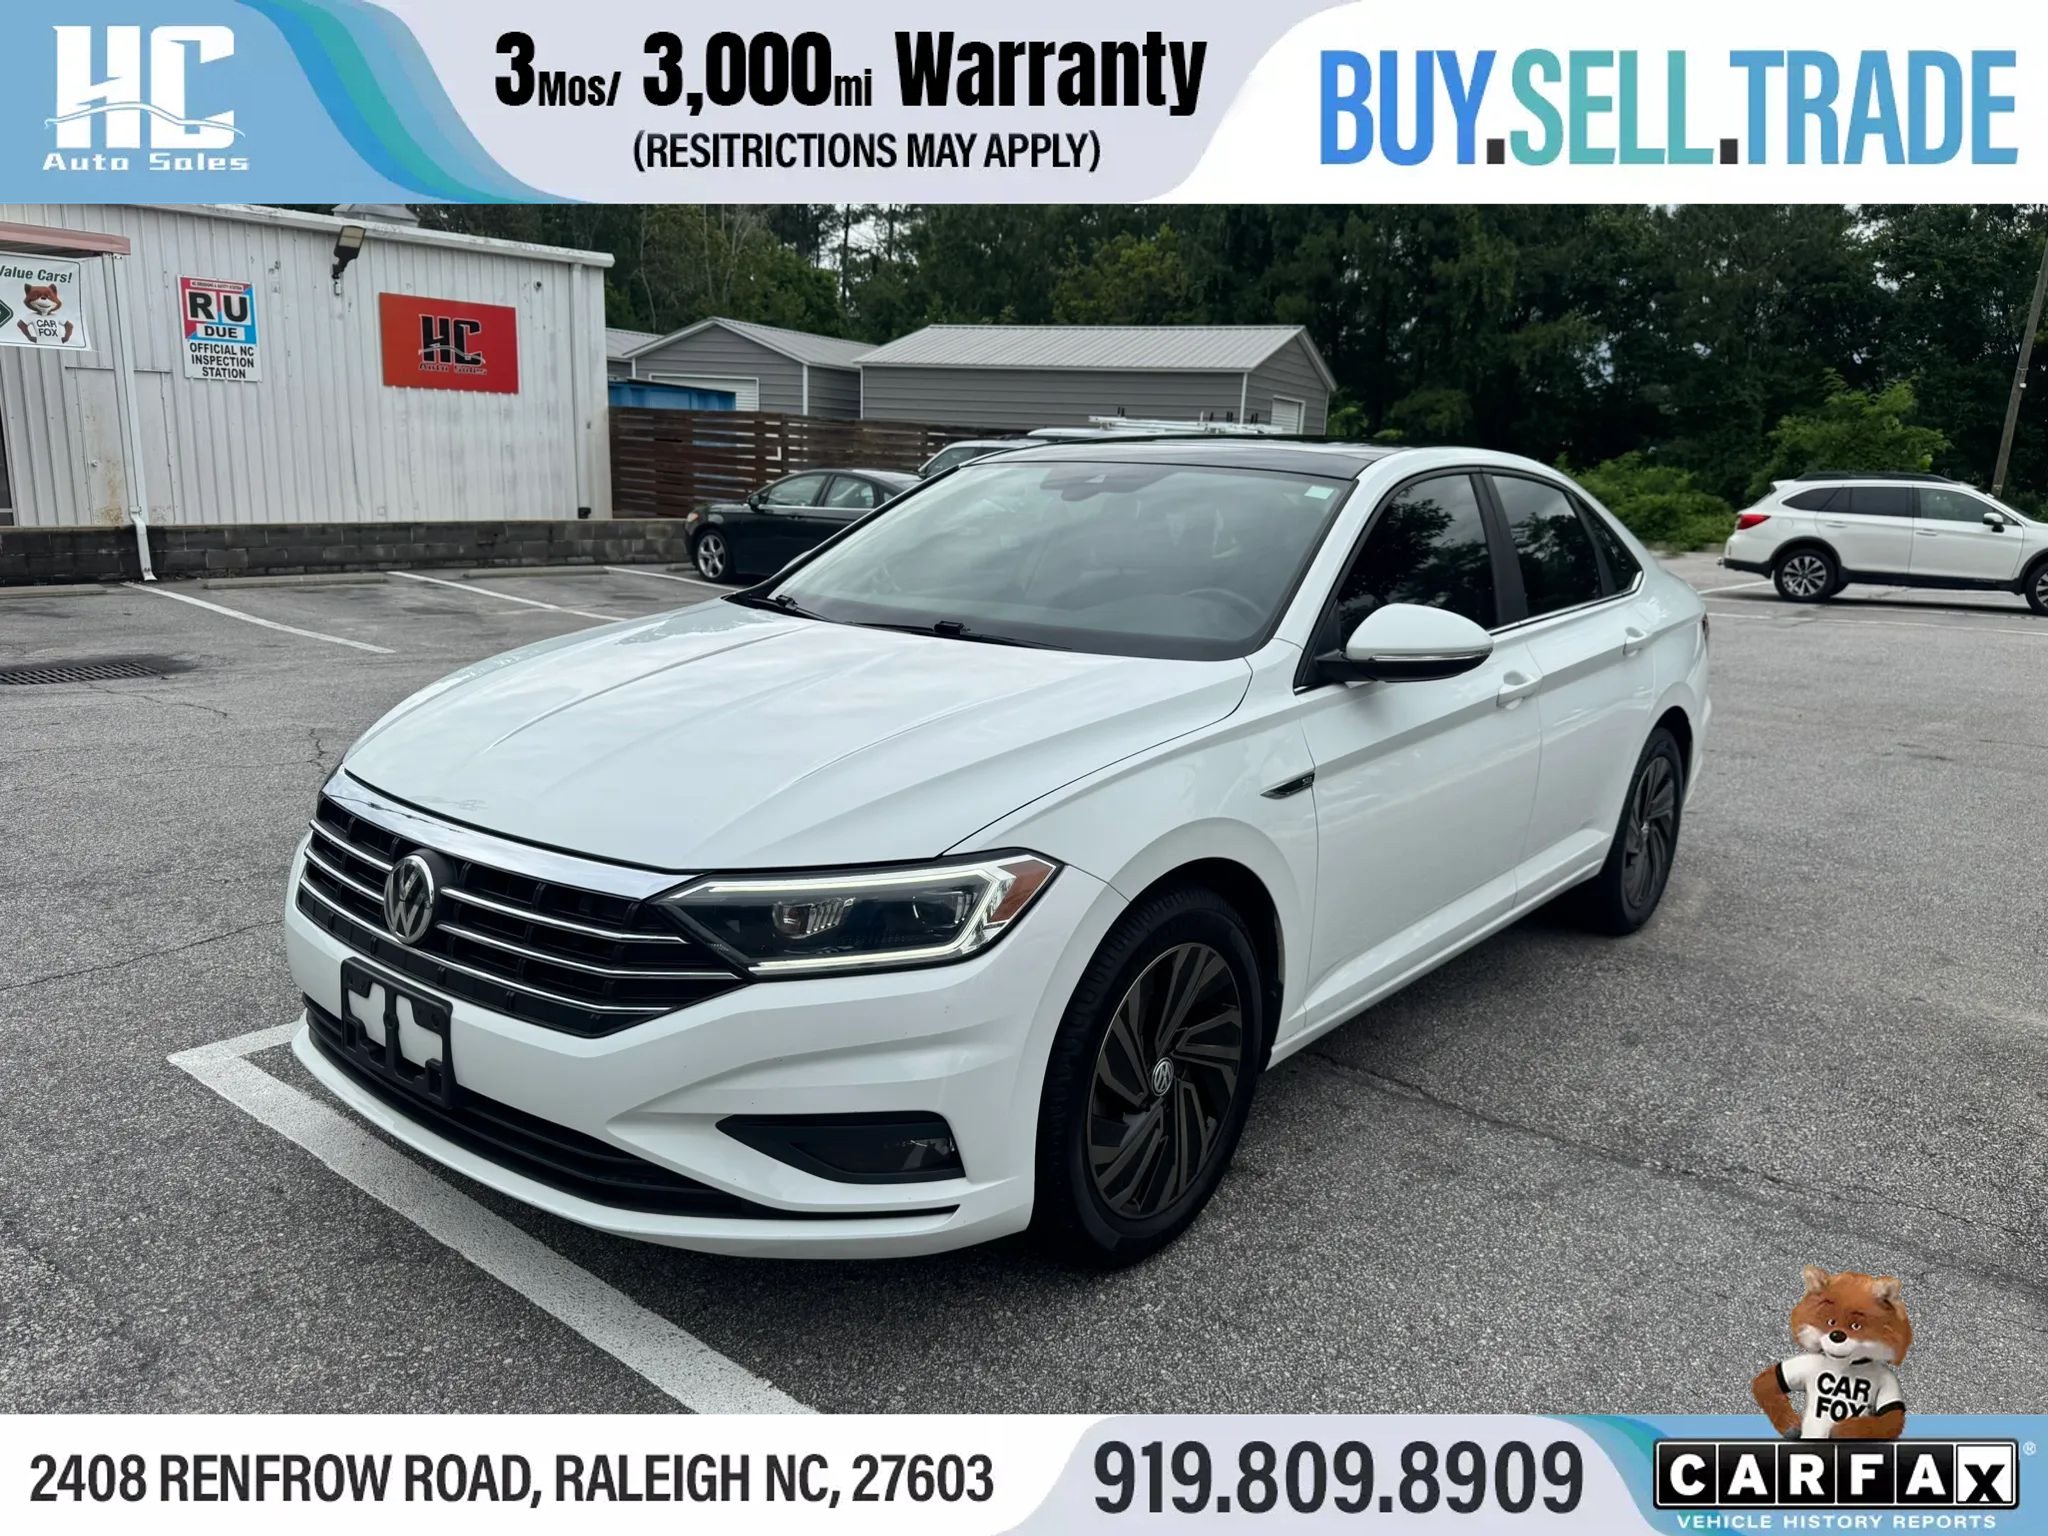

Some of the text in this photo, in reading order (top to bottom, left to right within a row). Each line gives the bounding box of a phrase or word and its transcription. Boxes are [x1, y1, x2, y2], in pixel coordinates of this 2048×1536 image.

[37, 269, 73, 284] Cars!
[36, 319, 57, 328] CAR
[38, 328, 58, 337] FOX
[204, 325, 238, 339] DUE
[418, 313, 482, 367] HC
[189, 342, 254, 357] OFFICIAL NC
[191, 354, 255, 368] INSPECTION
[202, 366, 247, 379] STATION
